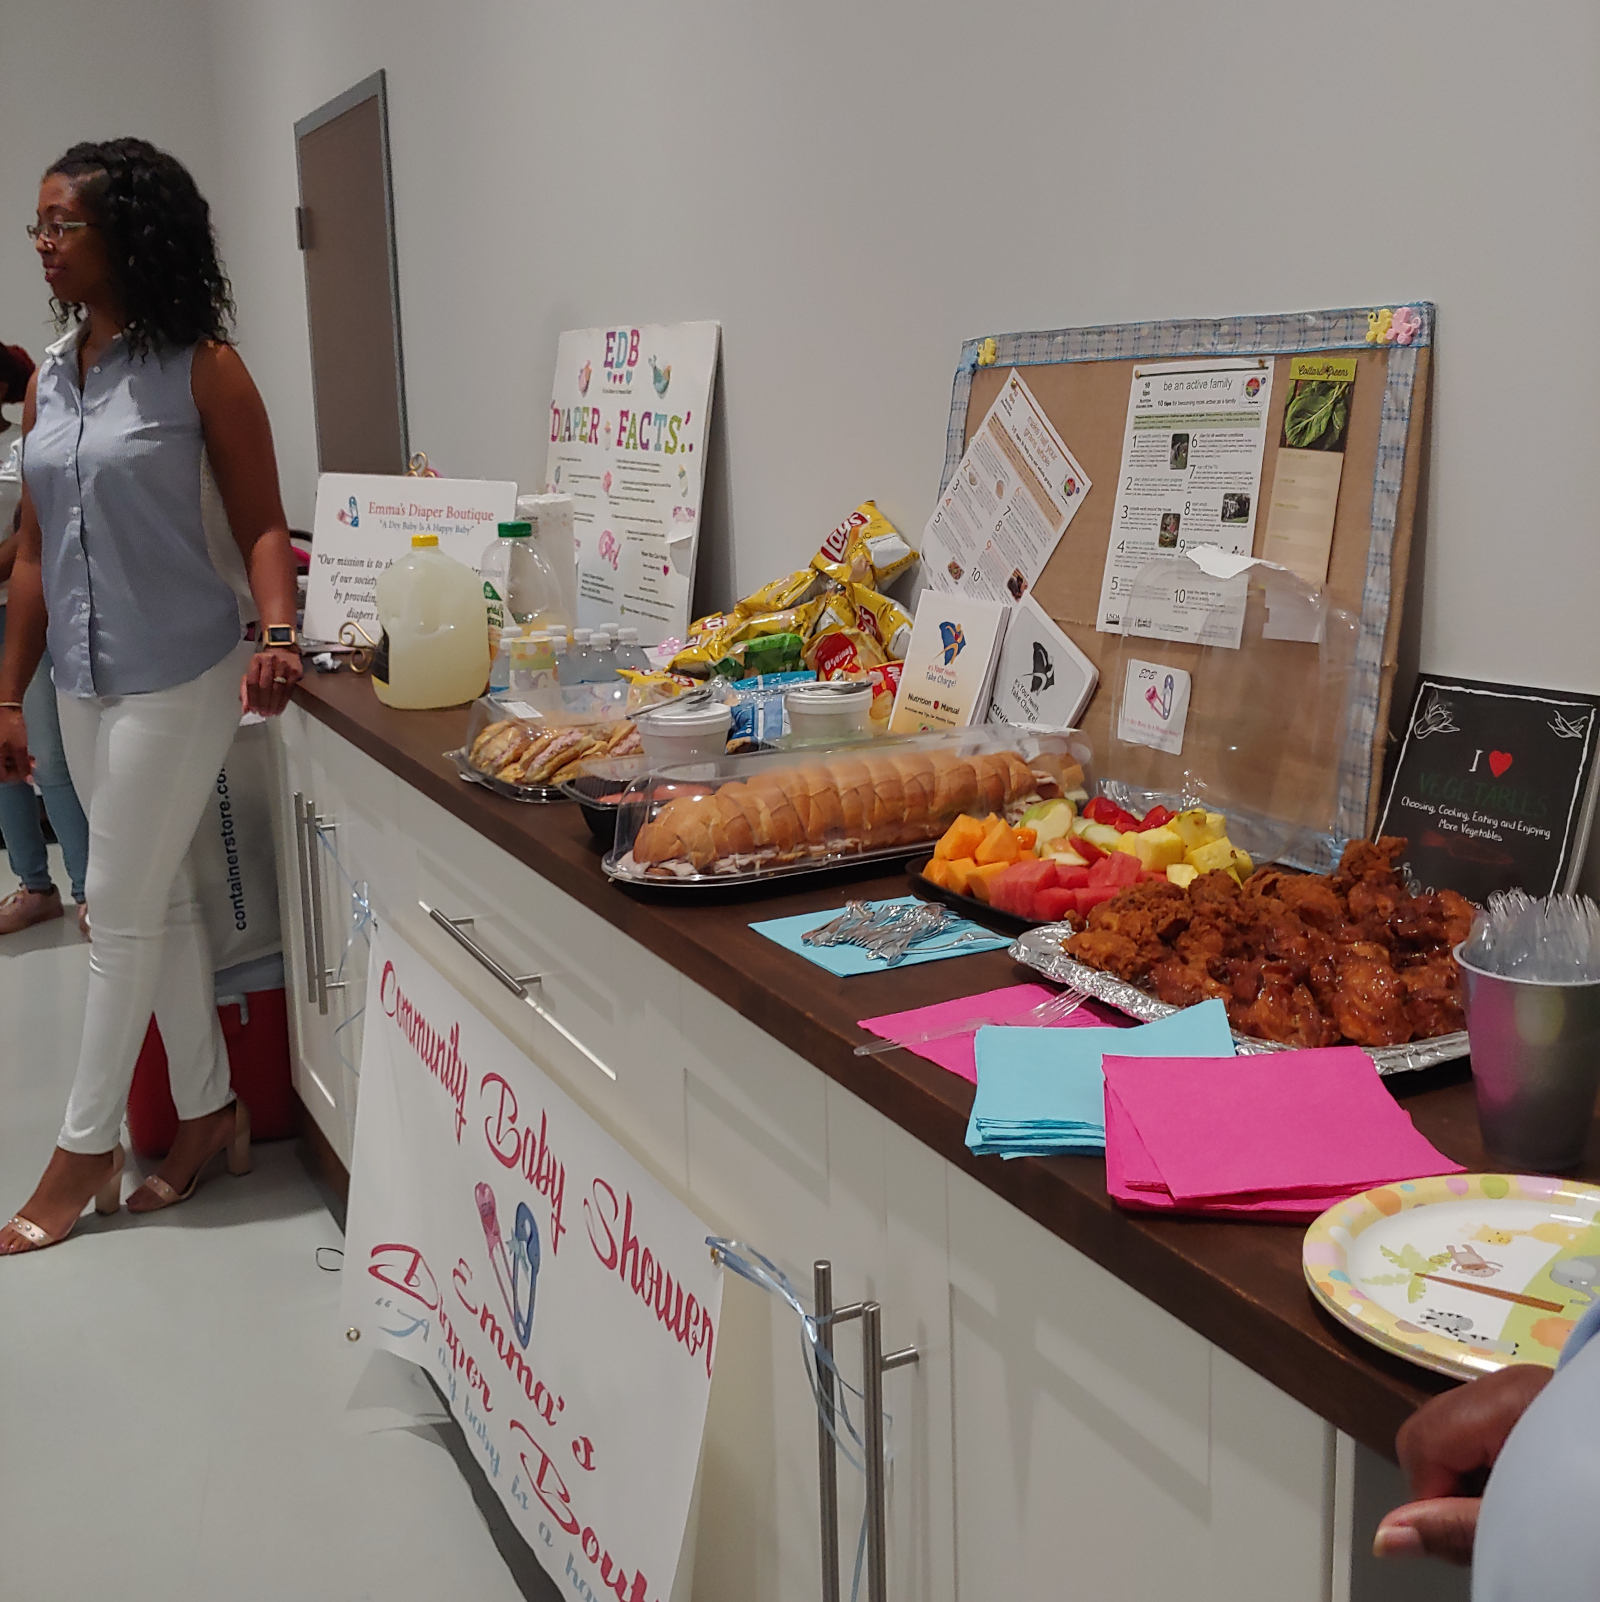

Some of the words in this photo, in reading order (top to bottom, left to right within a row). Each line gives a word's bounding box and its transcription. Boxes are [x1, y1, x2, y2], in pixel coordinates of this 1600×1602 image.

[603, 329, 640, 369] EDB
[1327, 366, 1349, 379] Greens
[1163, 381, 1173, 391] be
[1174, 382, 1184, 391] an
[1186, 379, 1208, 390] active
[1210, 378, 1233, 391] family
[1132, 434, 1137, 448] 1
[1191, 433, 1198, 448] 6
[1189, 464, 1197, 479] 7
[953, 479, 960, 490] 3
[1126, 476, 1133, 490] 2
[368, 501, 406, 516] Emma's
[409, 503, 444, 521] Diaper
[446, 506, 495, 525] Boutique
[1003, 505, 1011, 516] 7
[1121, 505, 1129, 519] 3
[1184, 501, 1190, 515] 8
[935, 512, 942, 523] 5
[402, 521, 417, 531] Baby
[995, 520, 1002, 531] 8
[985, 540, 992, 551] 9
[1117, 539, 1126, 553] 4
[1180, 539, 1186, 553] 9
[337, 556, 365, 568] mission
[367, 558, 373, 568] is
[375, 559, 383, 569] to
[330, 571, 341, 586] of
[340, 576, 352, 584] our
[971, 567, 981, 582] 10
[1111, 576, 1119, 590] 5
[333, 588, 342, 604] by
[1174, 589, 1186, 603] 10
[347, 607, 374, 623] diapers
[908, 692, 932, 706] Nutrition
[941, 702, 960, 715] Manual
[1468, 750, 1484, 773] I
[1401, 796, 1436, 815] Choosing,
[1438, 804, 1470, 822] Cooking,
[1472, 811, 1498, 829] Eating
[1500, 820, 1515, 830] and
[1518, 820, 1551, 840] Enjoying
[1438, 818, 1458, 832] More
[1461, 823, 1503, 841] Vegetables
[217, 768, 247, 931] containerstore.co
[480, 1072, 566, 1256] Baby
[584, 1178, 714, 1379] Shower
[368, 1243, 494, 1412] Diaper
[538, 1521, 553, 1547] a
